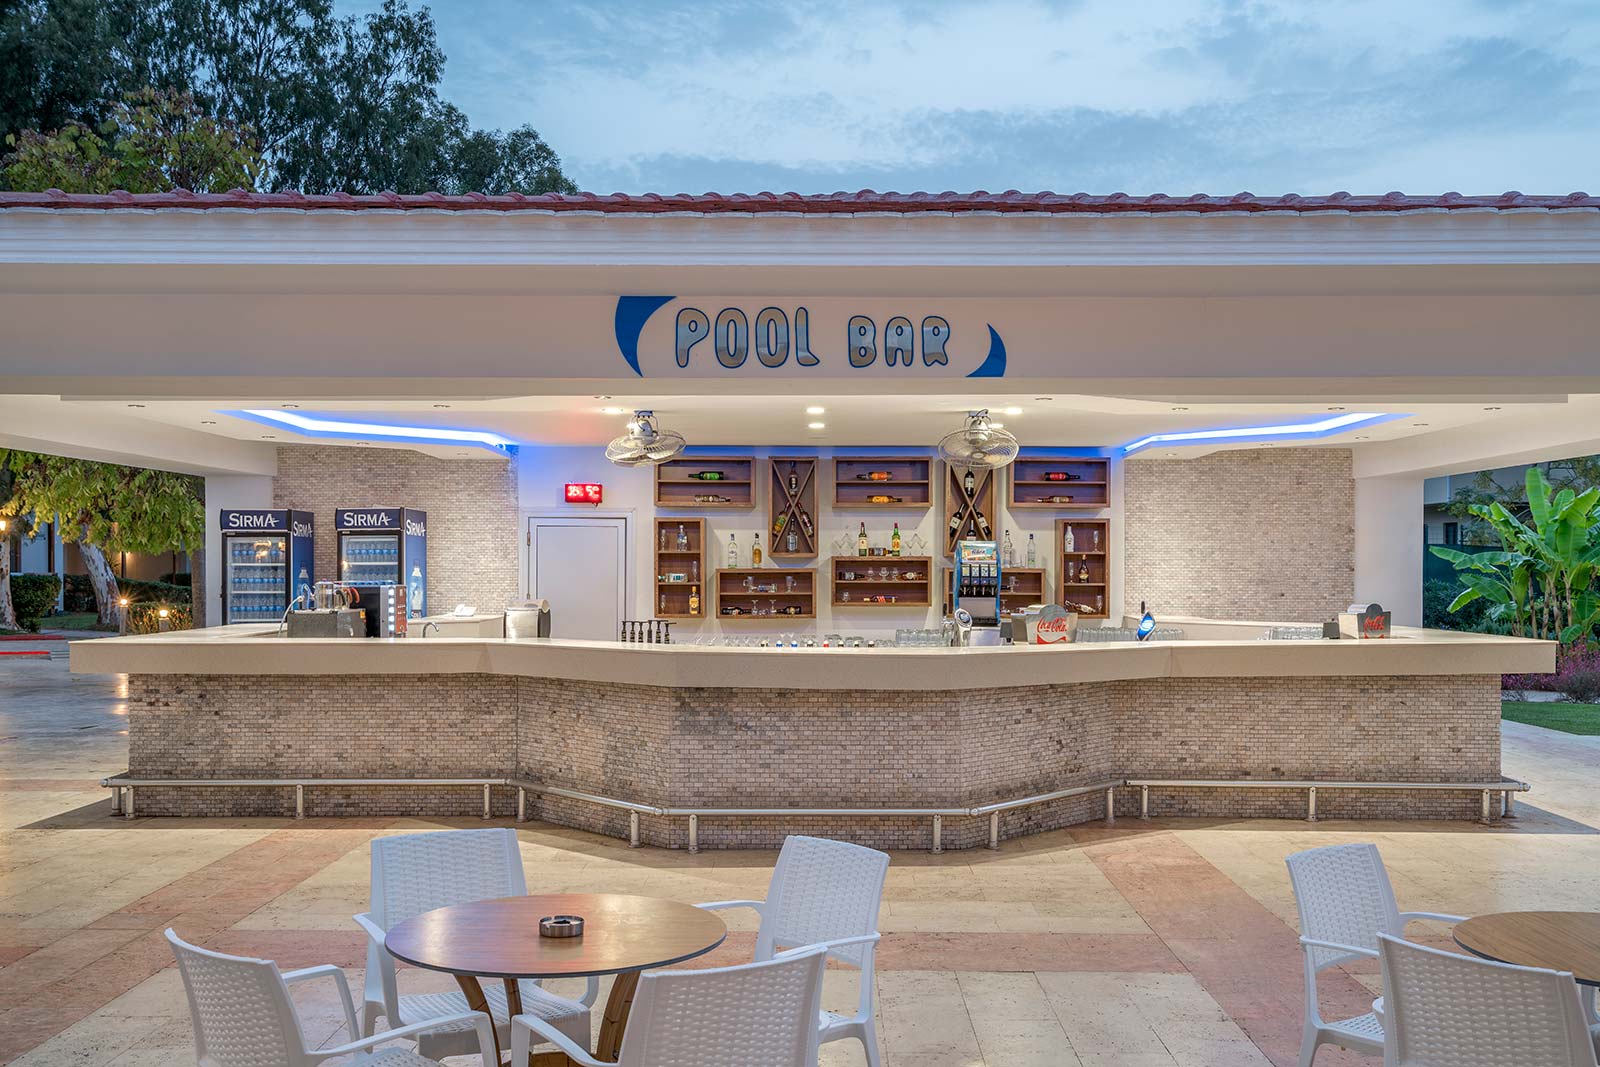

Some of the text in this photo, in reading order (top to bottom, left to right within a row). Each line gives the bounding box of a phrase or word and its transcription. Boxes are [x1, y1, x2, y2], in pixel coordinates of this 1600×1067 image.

[675, 307, 951, 368] POOL BAR
[229, 513, 279, 527] SIRMA
[344, 512, 392, 527] SIRMA
